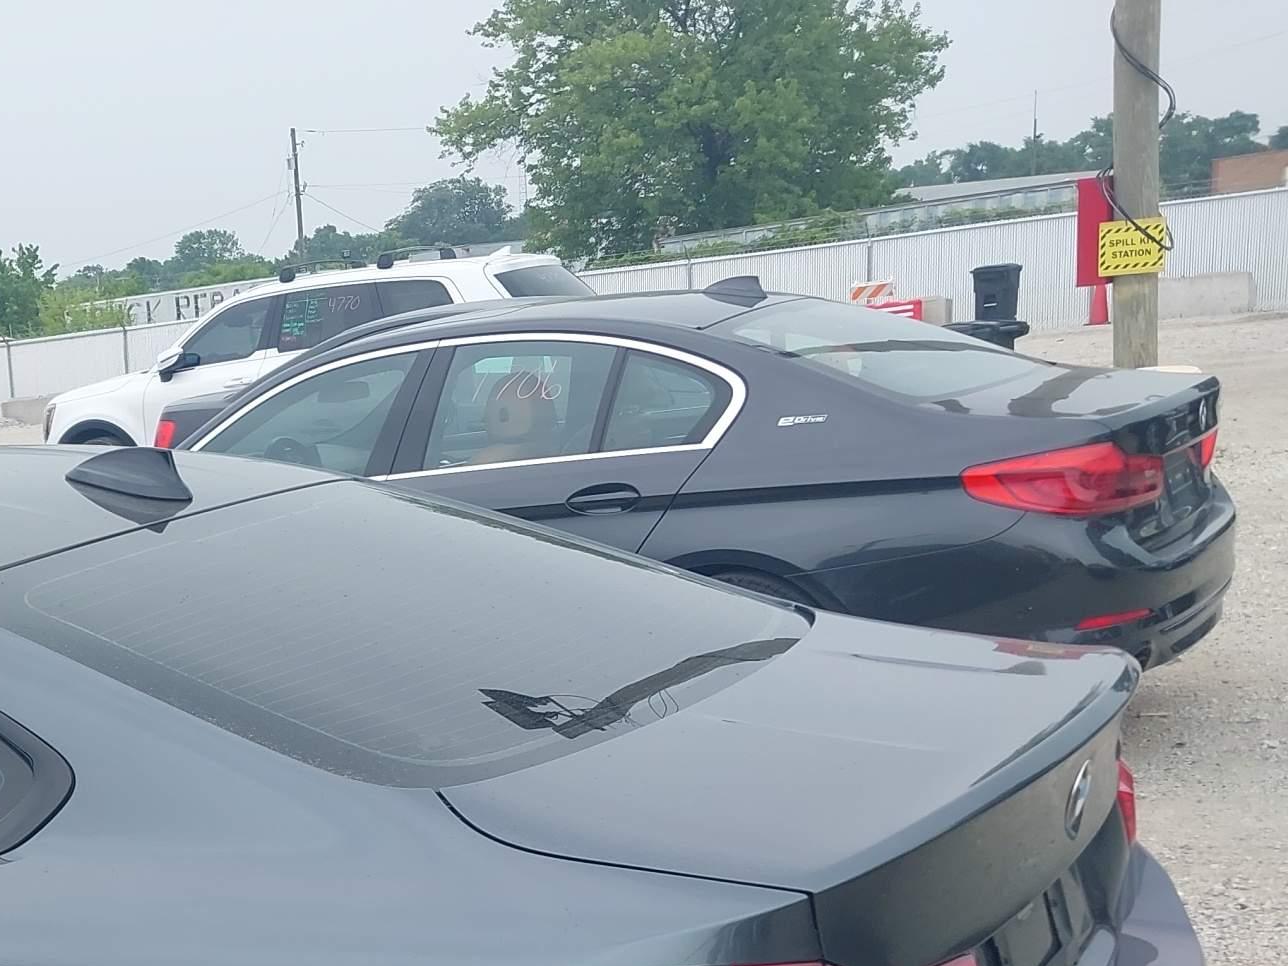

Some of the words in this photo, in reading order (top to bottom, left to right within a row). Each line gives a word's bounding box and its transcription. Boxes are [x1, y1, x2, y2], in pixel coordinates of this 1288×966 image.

[1109, 238, 1137, 248] SPILL
[1140, 236, 1156, 245] KI
[1112, 248, 1153, 259] STATION
[328, 295, 361, 313] 4770
